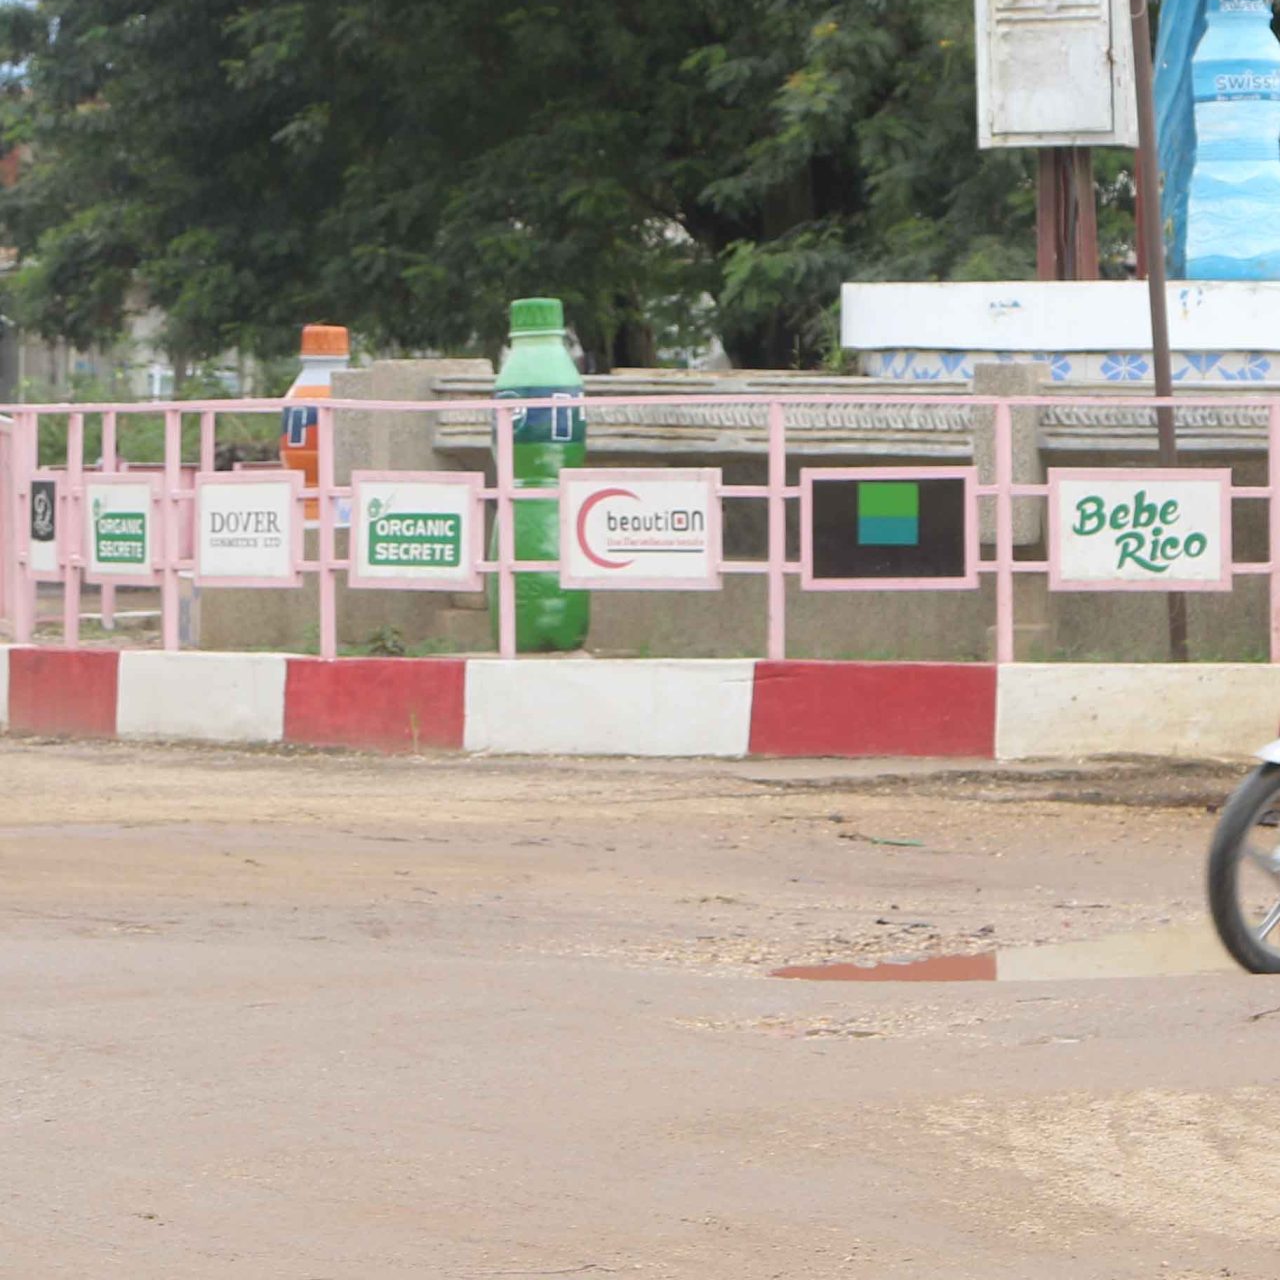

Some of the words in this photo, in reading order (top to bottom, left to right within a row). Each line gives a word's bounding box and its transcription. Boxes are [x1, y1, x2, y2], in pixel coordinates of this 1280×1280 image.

[210, 510, 281, 533] DOVER
[1072, 490, 1181, 536] Bebe
[375, 519, 455, 536] ORGANIC
[375, 542, 455, 561] SECRETE
[1115, 526, 1208, 573] Rico
